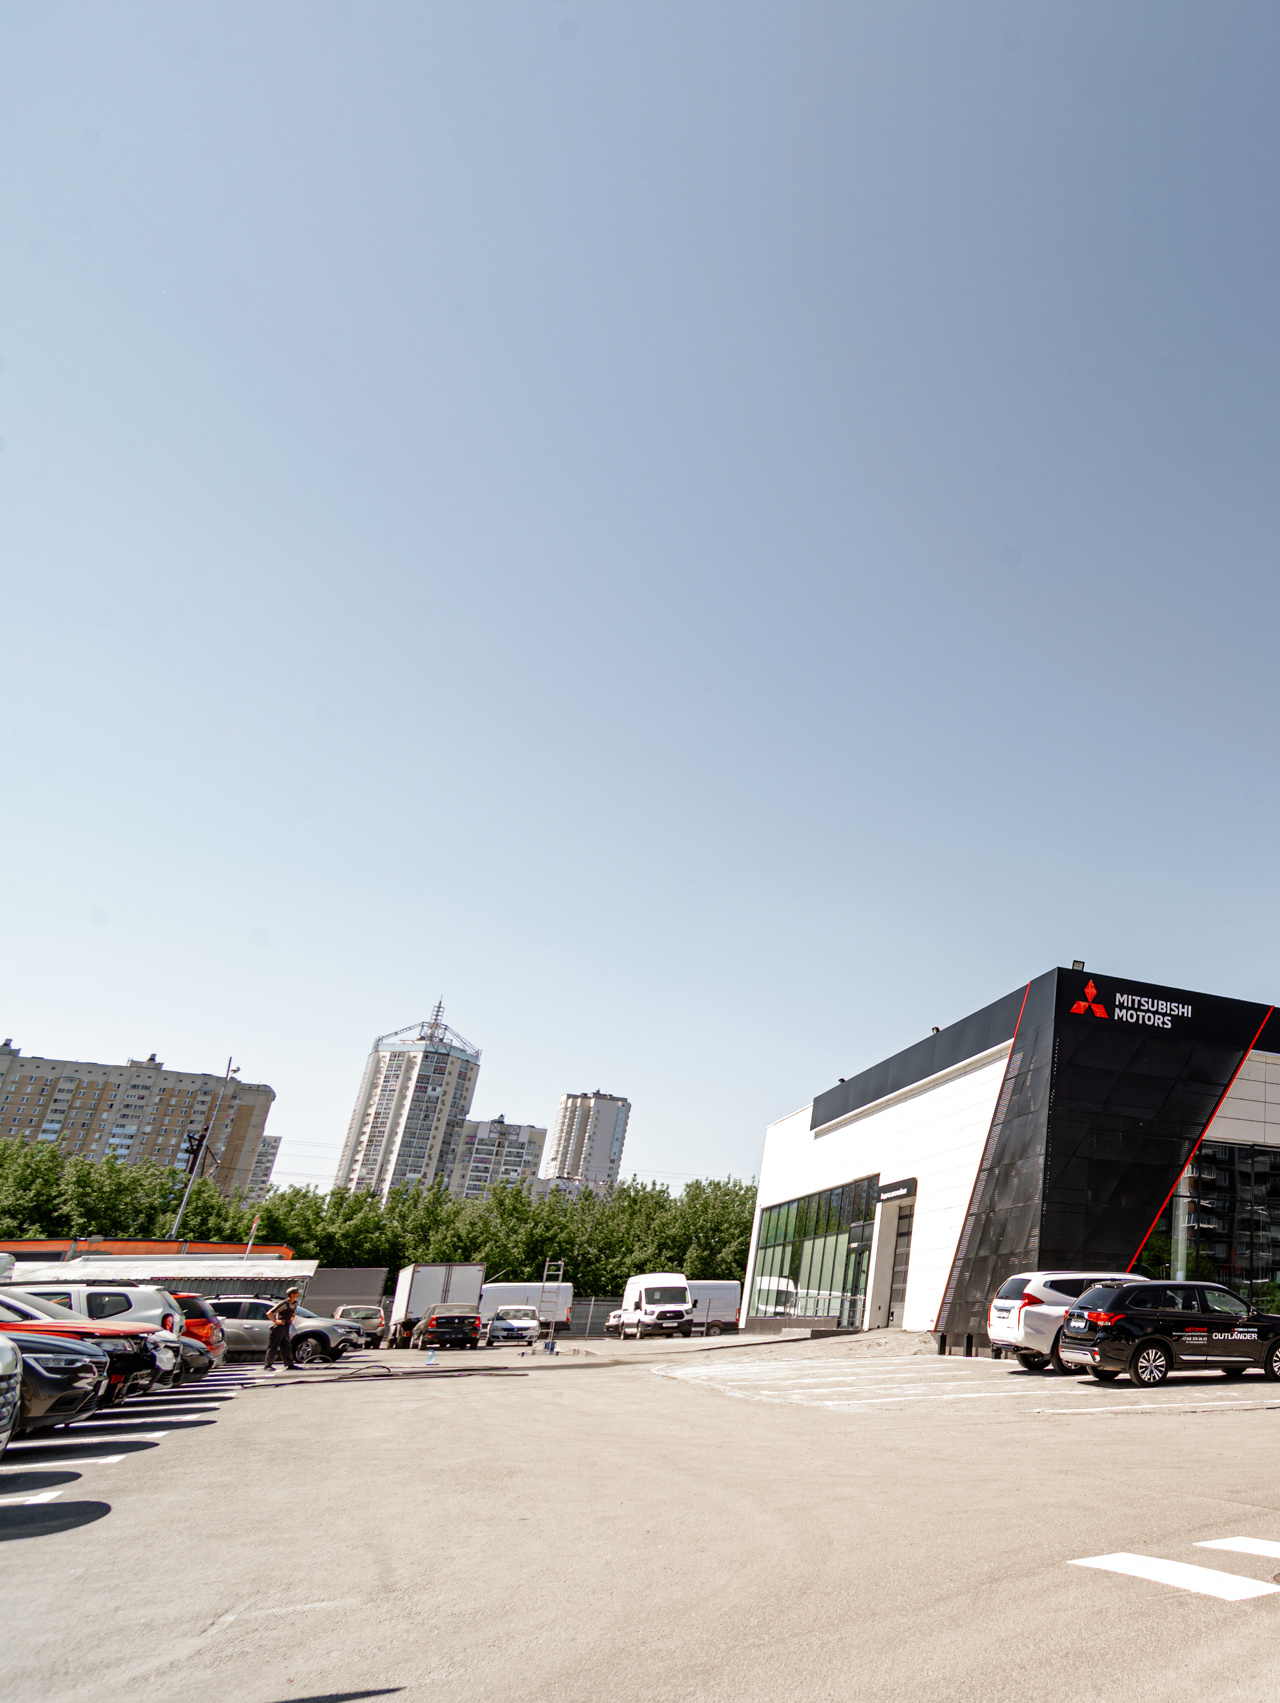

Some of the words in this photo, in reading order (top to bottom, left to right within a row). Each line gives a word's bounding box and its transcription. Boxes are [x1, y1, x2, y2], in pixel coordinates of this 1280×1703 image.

[1115, 992, 1191, 1018] MITSUBISHI
[1114, 1007, 1172, 1029] MOTORS
[1212, 1332, 1258, 1340] OUTLANDER
